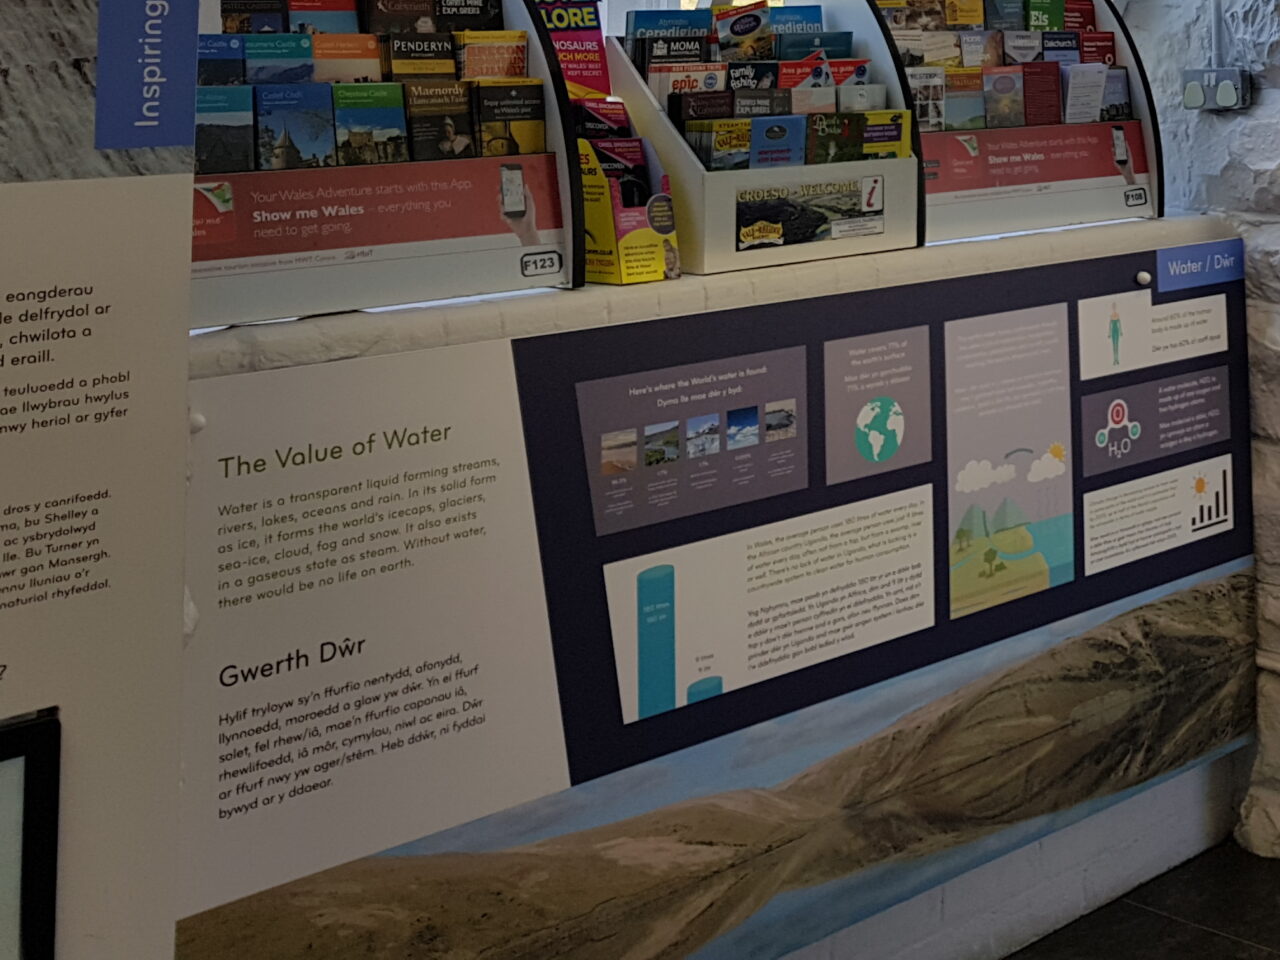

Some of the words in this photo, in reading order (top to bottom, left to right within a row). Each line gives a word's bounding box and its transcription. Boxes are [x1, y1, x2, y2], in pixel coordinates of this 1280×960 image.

[442, 6, 481, 15] EXPLORERS
[541, 6, 598, 29] LORE
[636, 26, 709, 39] Ceredigion
[393, 39, 452, 52] PENDERYN
[670, 40, 700, 51] MOMA
[135, 0, 169, 127] Inspiring
[575, 52, 601, 62] MORE
[730, 65, 756, 78] Family
[783, 66, 796, 74] Area
[797, 67, 812, 76] guide
[411, 84, 464, 97] Maenordy
[672, 78, 700, 93] epic
[988, 154, 1009, 165] Show
[1010, 154, 1021, 162] me
[1022, 153, 1045, 162] Wales
[250, 191, 277, 204] Your
[279, 189, 314, 201] Wales
[316, 186, 372, 198] Adventure
[376, 183, 404, 194] starts
[407, 181, 428, 192] with
[431, 180, 448, 191] this
[737, 186, 790, 201] CROESO
[800, 180, 860, 197] WELCOME
[253, 209, 295, 223] Show
[296, 209, 318, 219] me
[321, 205, 364, 217] Wales
[378, 200, 431, 214] everything
[433, 200, 452, 212] you
[254, 224, 283, 238] need
[286, 224, 298, 236] to
[300, 224, 319, 239] get
[523, 258, 556, 271] F123
[1168, 259, 1203, 276] Water
[1205, 254, 1211, 273] /
[5, 284, 94, 304] eangderau
[18, 303, 90, 323] delfrydol
[94, 304, 112, 316] ar
[8, 327, 77, 345] chwilota
[81, 327, 92, 337] a
[3, 377, 74, 398] teuluoedd
[78, 379, 88, 388] a
[92, 370, 130, 389] phobl
[629, 386, 652, 397] Here's
[654, 383, 675, 392] where
[677, 380, 690, 388] the
[690, 375, 717, 385] World's
[718, 371, 737, 381] water
[22, 397, 80, 414] llwybrau
[84, 390, 130, 405] hwylus
[31, 412, 71, 430] heriol
[74, 413, 90, 424] ar
[93, 406, 128, 424] gyfer
[217, 454, 267, 479] The
[274, 443, 343, 469] Value
[352, 432, 377, 456] of
[382, 425, 452, 450] Water
[217, 502, 258, 516] Water
[262, 499, 273, 510] is
[276, 497, 285, 506] a
[289, 481, 363, 504] transparent
[366, 473, 400, 490] liquid
[403, 467, 449, 483] forming
[452, 458, 500, 474] streams,
[217, 521, 257, 536] rivers,
[261, 513, 298, 528] lakes,
[301, 503, 347, 520] oceans
[350, 495, 374, 510] and
[378, 492, 404, 505] rain.
[408, 488, 419, 499] In
[423, 485, 437, 496] its
[440, 477, 467, 494] solid
[470, 475, 496, 486] form
[217, 543, 234, 554] as
[237, 539, 260, 550] ice,
[264, 533, 273, 545] it
[276, 527, 315, 542] forms
[318, 522, 339, 534] the
[342, 512, 384, 529] world's
[388, 504, 435, 520] icecaps,
[438, 493, 486, 512] glaciers,
[218, 555, 270, 573] sea-ice,
[274, 543, 313, 561] cloud,
[316, 540, 338, 552] fog
[341, 532, 365, 547] and
[369, 528, 401, 542] snow.
[405, 522, 414, 534] It
[417, 519, 442, 531] also
[444, 511, 477, 525] exists
[218, 580, 230, 591] in
[234, 578, 244, 588] a
[247, 565, 302, 588] gaseous
[305, 557, 338, 572] state
[340, 554, 356, 565] as
[359, 545, 400, 561] steam.
[403, 532, 450, 551] Without
[453, 526, 486, 540] water,
[218, 594, 253, 609] there
[256, 582, 294, 600] would
[298, 580, 314, 592] be
[318, 576, 334, 588] no
[338, 569, 358, 583] life
[360, 567, 376, 578] on
[380, 557, 414, 574] earth.
[218, 648, 310, 688] Gwerth
[320, 637, 366, 664] Dŵr
